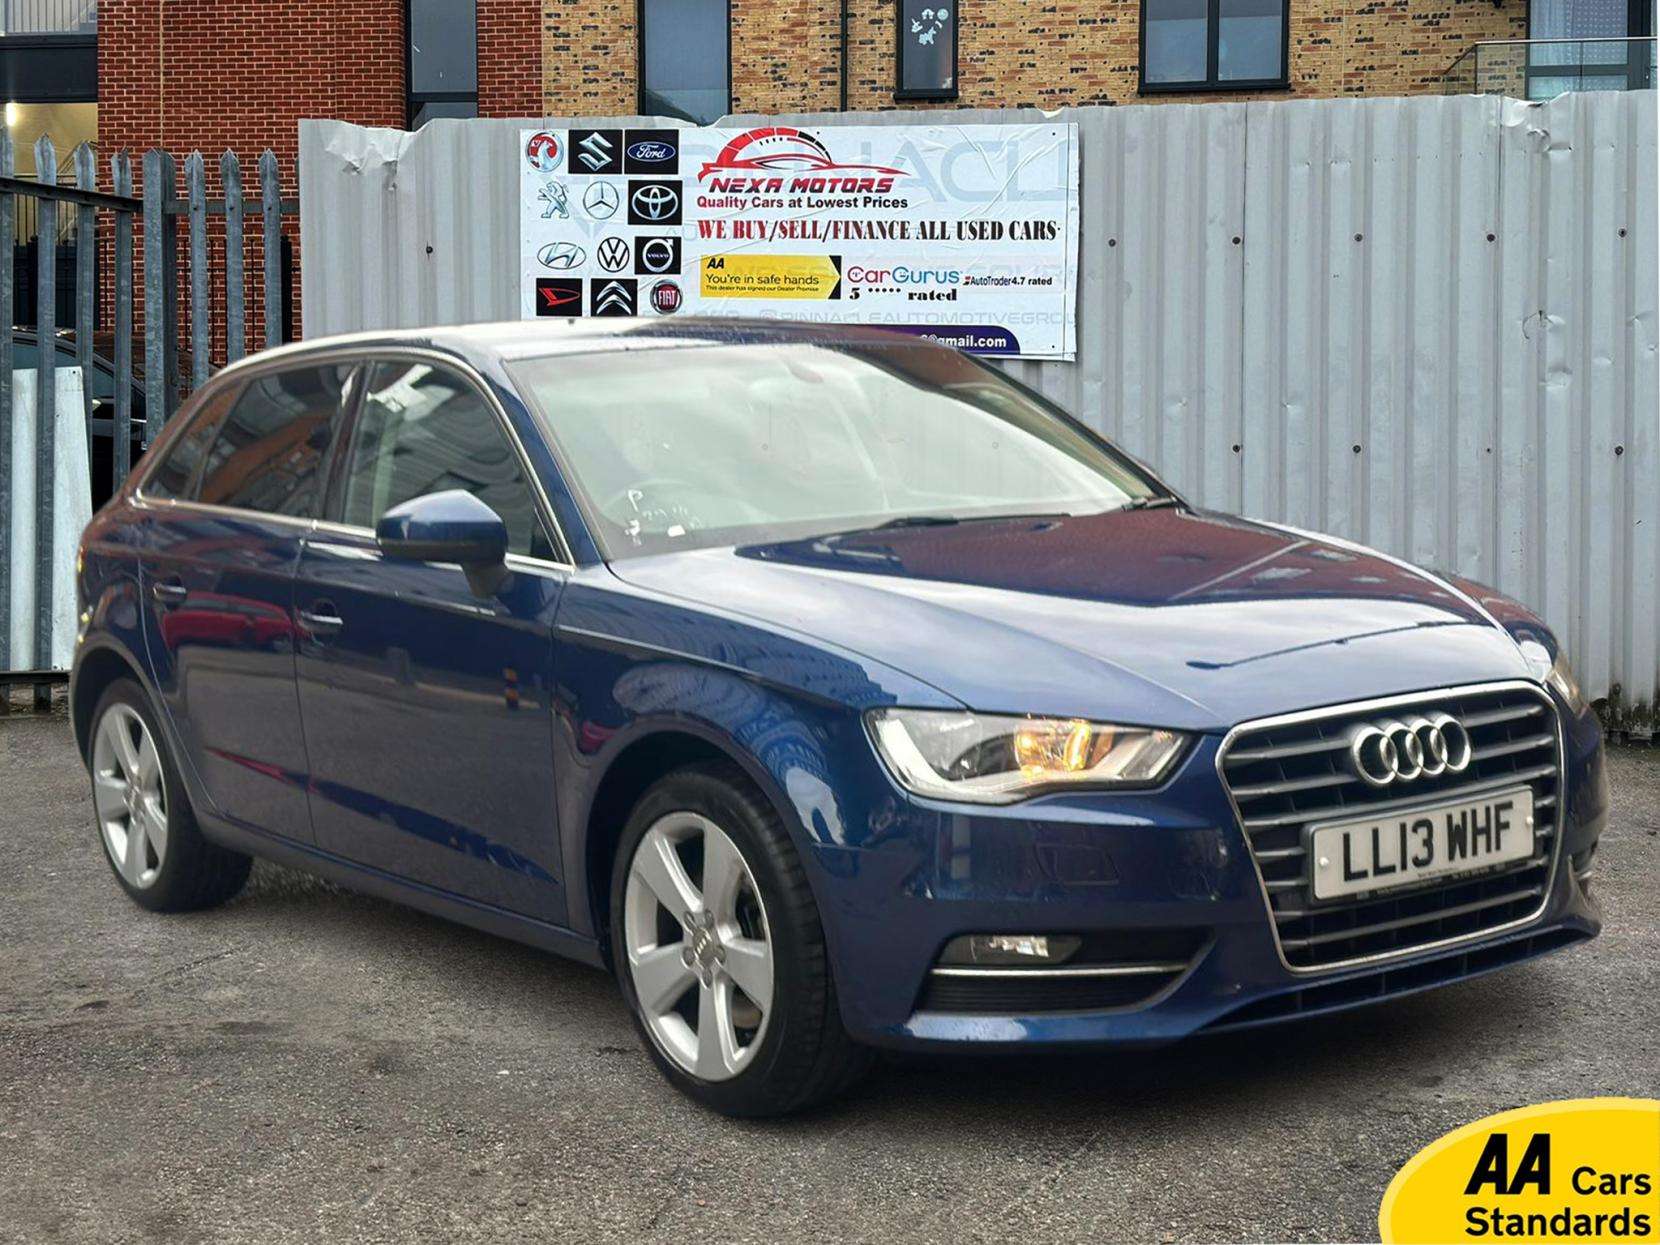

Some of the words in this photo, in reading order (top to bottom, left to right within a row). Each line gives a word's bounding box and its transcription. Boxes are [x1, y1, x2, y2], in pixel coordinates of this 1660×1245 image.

[636, 144, 666, 159] Ford
[709, 177, 781, 193] NEXA
[789, 177, 894, 193] MOTORS
[697, 196, 747, 210] Quality
[751, 196, 785, 208] Cars
[788, 197, 803, 208] at
[807, 196, 858, 208] Lowest
[863, 196, 908, 208] Prices
[697, 220, 727, 239] WE
[915, 220, 951, 239] ALL
[957, 220, 1003, 240] USED
[1009, 220, 1057, 240] CARS
[707, 257, 725, 269] AA
[706, 274, 741, 284] You're
[744, 274, 754, 283] in
[757, 274, 781, 285] safe
[784, 275, 819, 285] hands
[847, 265, 960, 284] CarGurus
[1028, 277, 1053, 285] rated
[658, 290, 677, 306] FIAT
[849, 287, 860, 300] 5
[908, 289, 957, 301] rated
[1343, 819, 1434, 882] LL13
[1446, 801, 1513, 862] WHF
